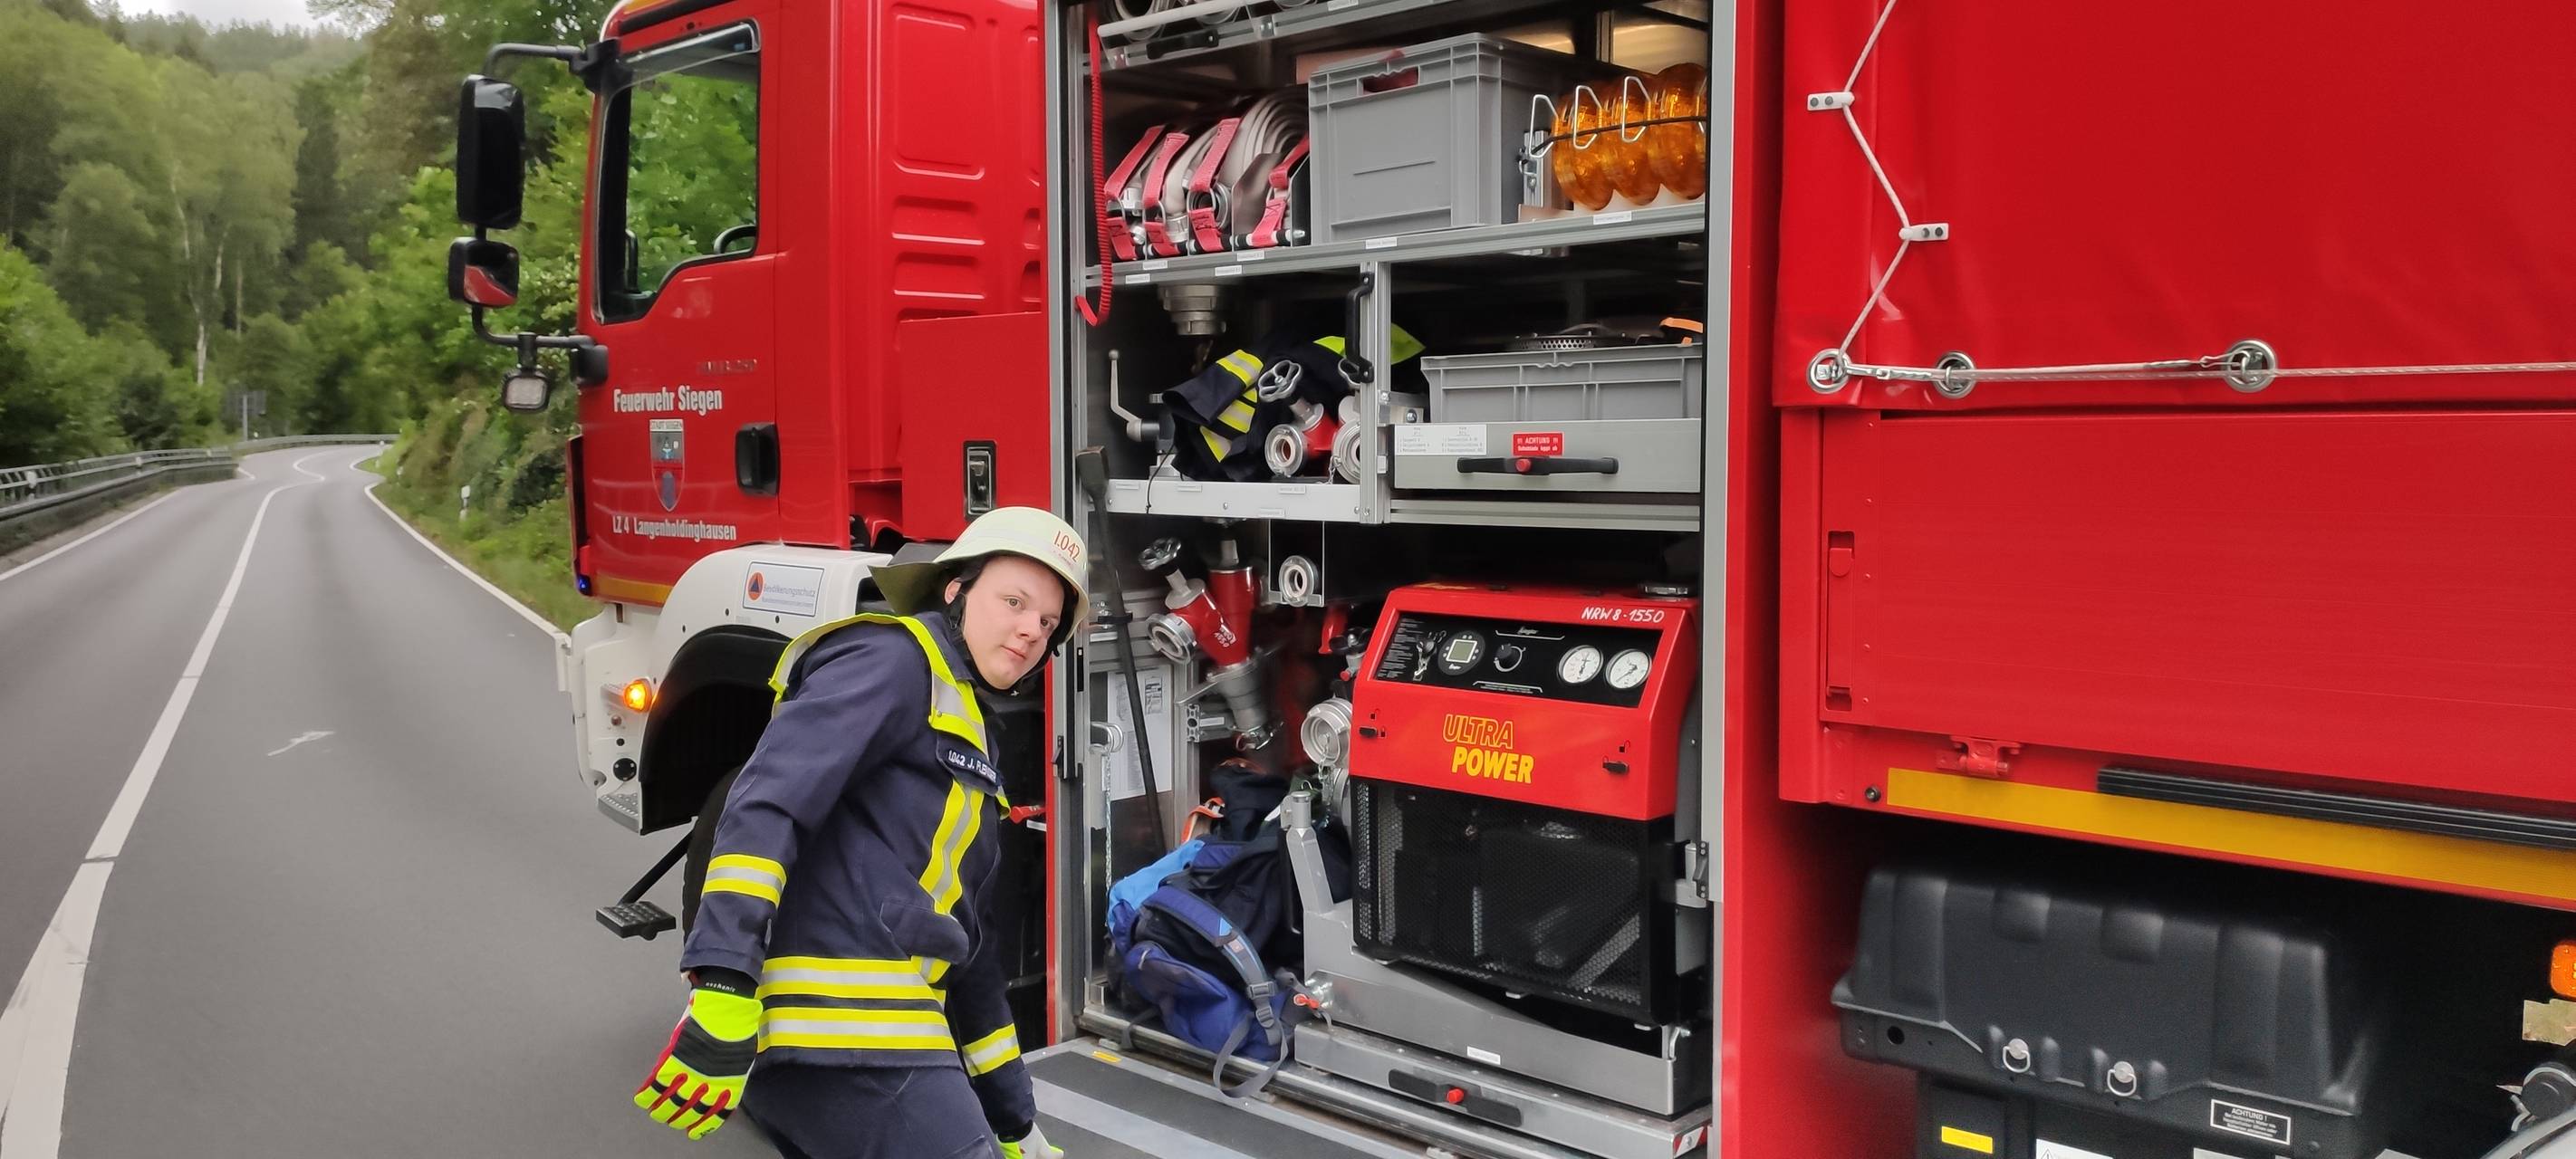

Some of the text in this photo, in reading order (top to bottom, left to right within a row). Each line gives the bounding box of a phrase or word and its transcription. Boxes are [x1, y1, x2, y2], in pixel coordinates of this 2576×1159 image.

[613, 385, 723, 417] Feuerwehr Siegen
[612, 515, 736, 542] LZ 4 Langenholdinghausen
[1442, 714, 1514, 750] ULTRA
[1451, 745, 1535, 784] POWER
[2231, 1107, 2263, 1120] ACHTUNG
